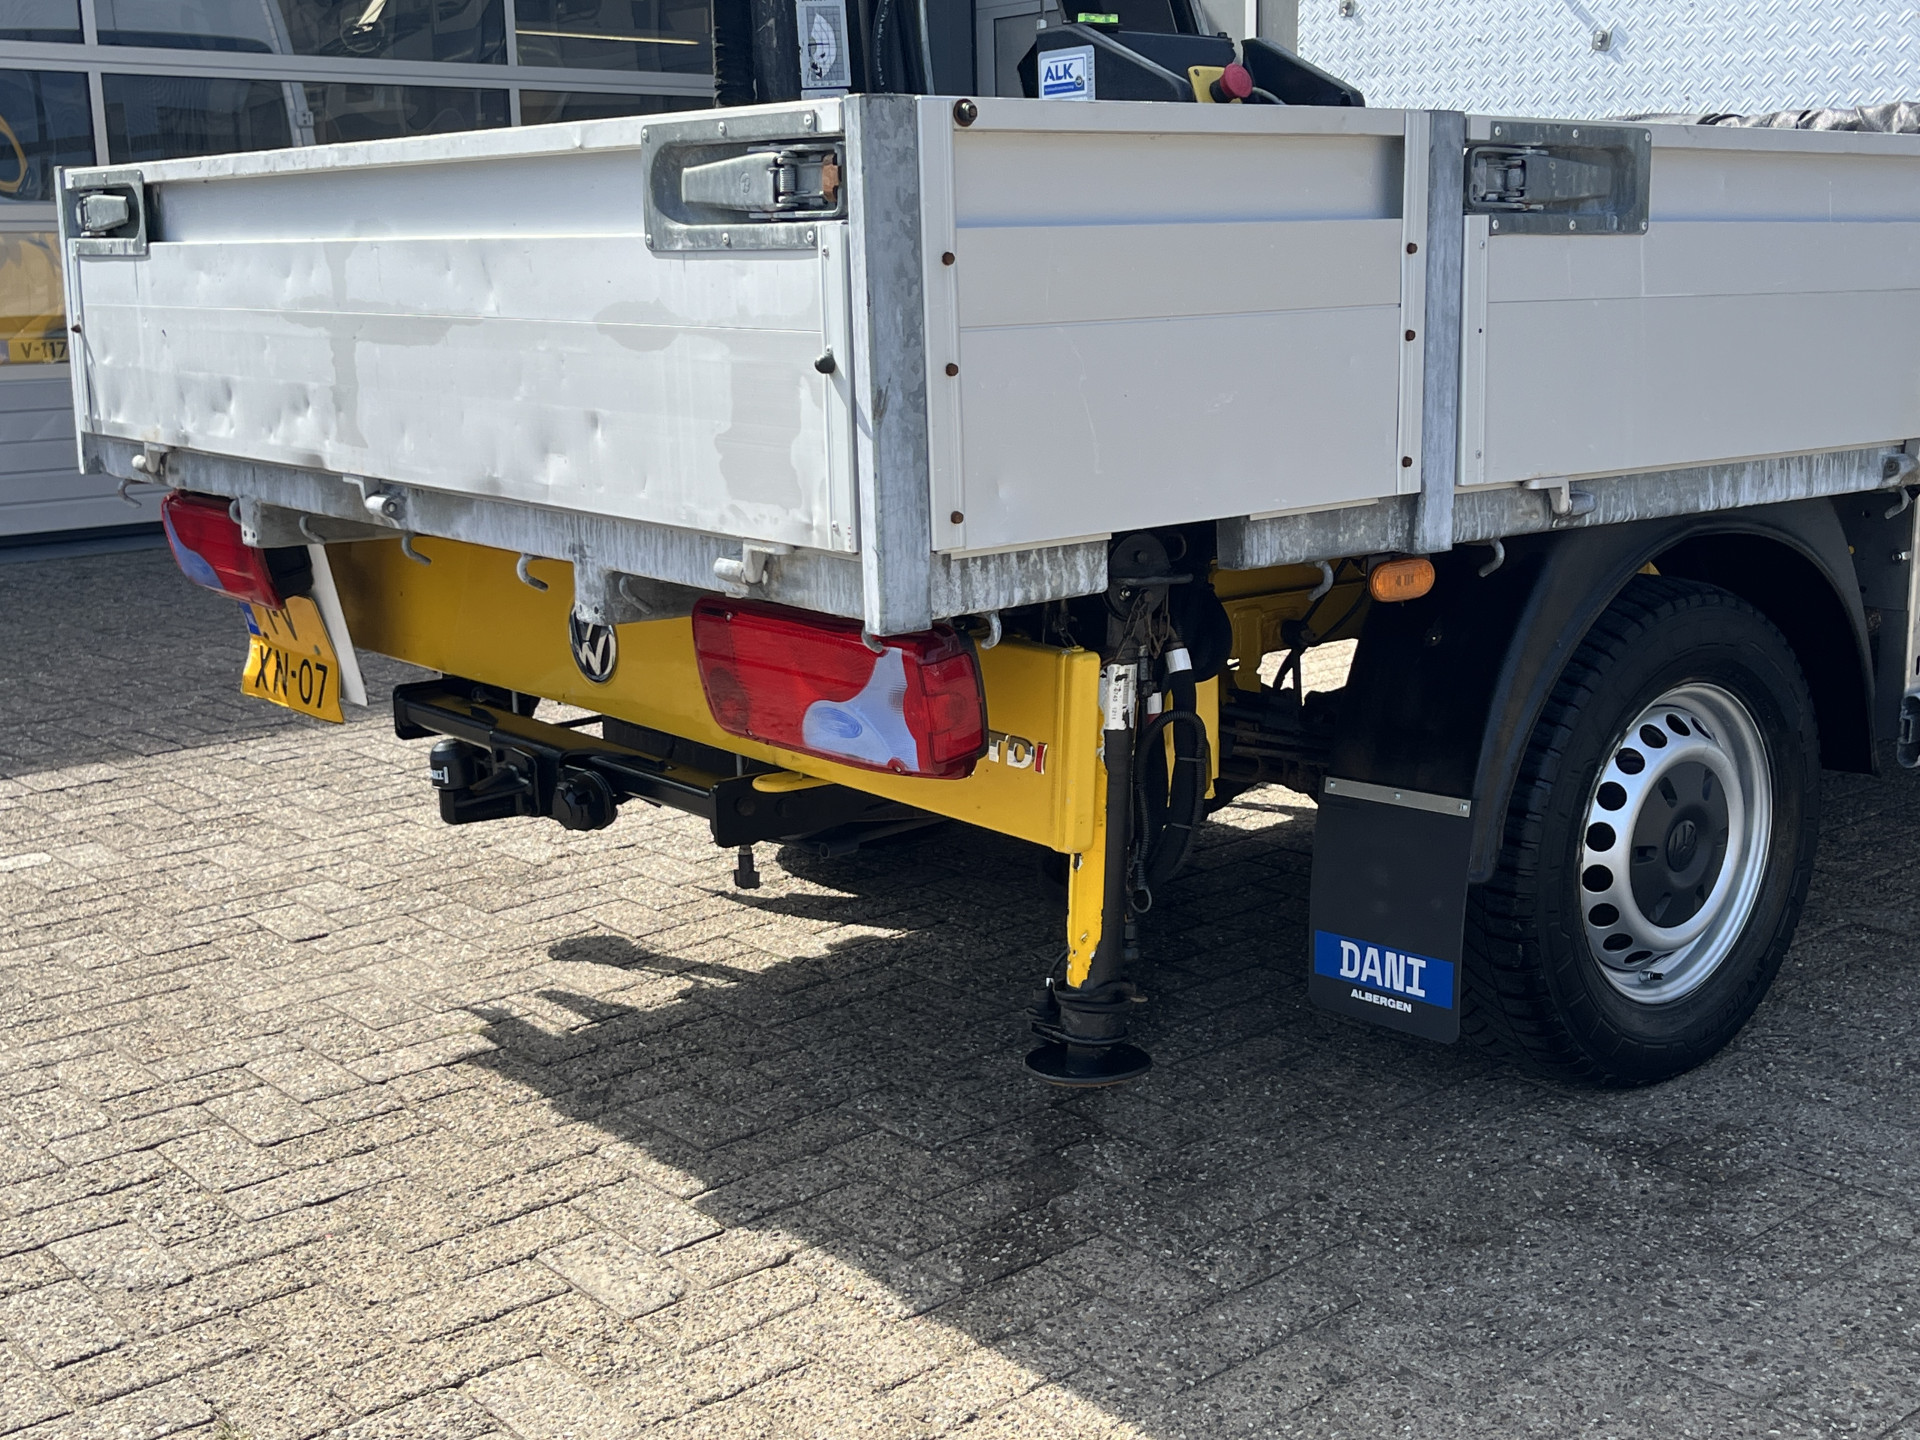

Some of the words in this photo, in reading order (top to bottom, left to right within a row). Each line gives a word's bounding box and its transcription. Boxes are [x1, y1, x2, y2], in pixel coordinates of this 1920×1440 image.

[1043, 62, 1074, 83] ALK
[254, 644, 329, 710] XN-07
[1339, 939, 1427, 999] DANI
[1350, 988, 1412, 1014] ALBERGEN
